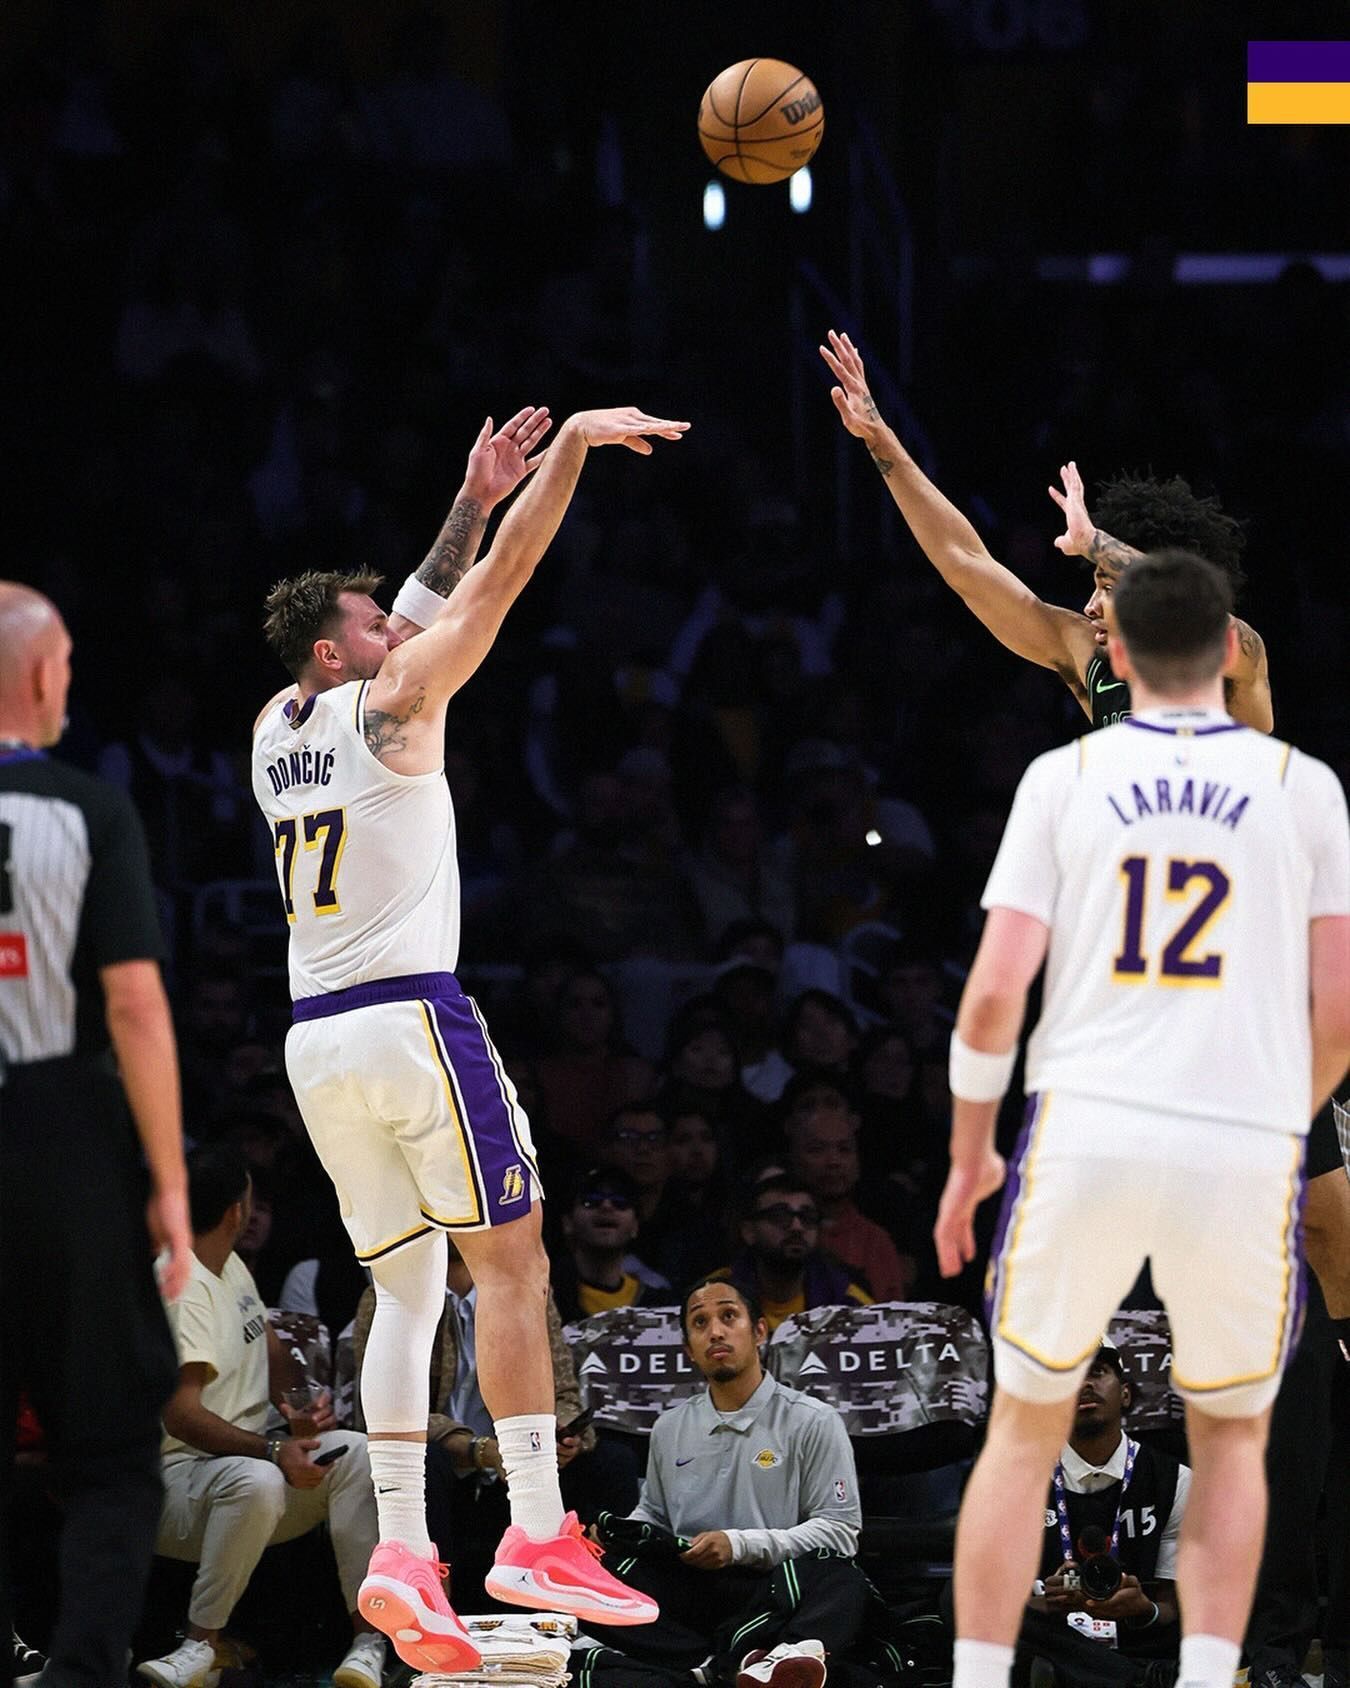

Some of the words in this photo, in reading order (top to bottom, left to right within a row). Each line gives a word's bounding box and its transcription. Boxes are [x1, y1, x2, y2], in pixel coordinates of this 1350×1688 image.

[266, 744, 335, 796] DONČIĆ
[1108, 779, 1250, 830] LARAVIA
[274, 805, 348, 923] 77
[1112, 854, 1232, 988] 12
[619, 1353, 693, 1374] DEL
[839, 1342, 961, 1372] DELTA
[1119, 1504, 1157, 1538] 15
